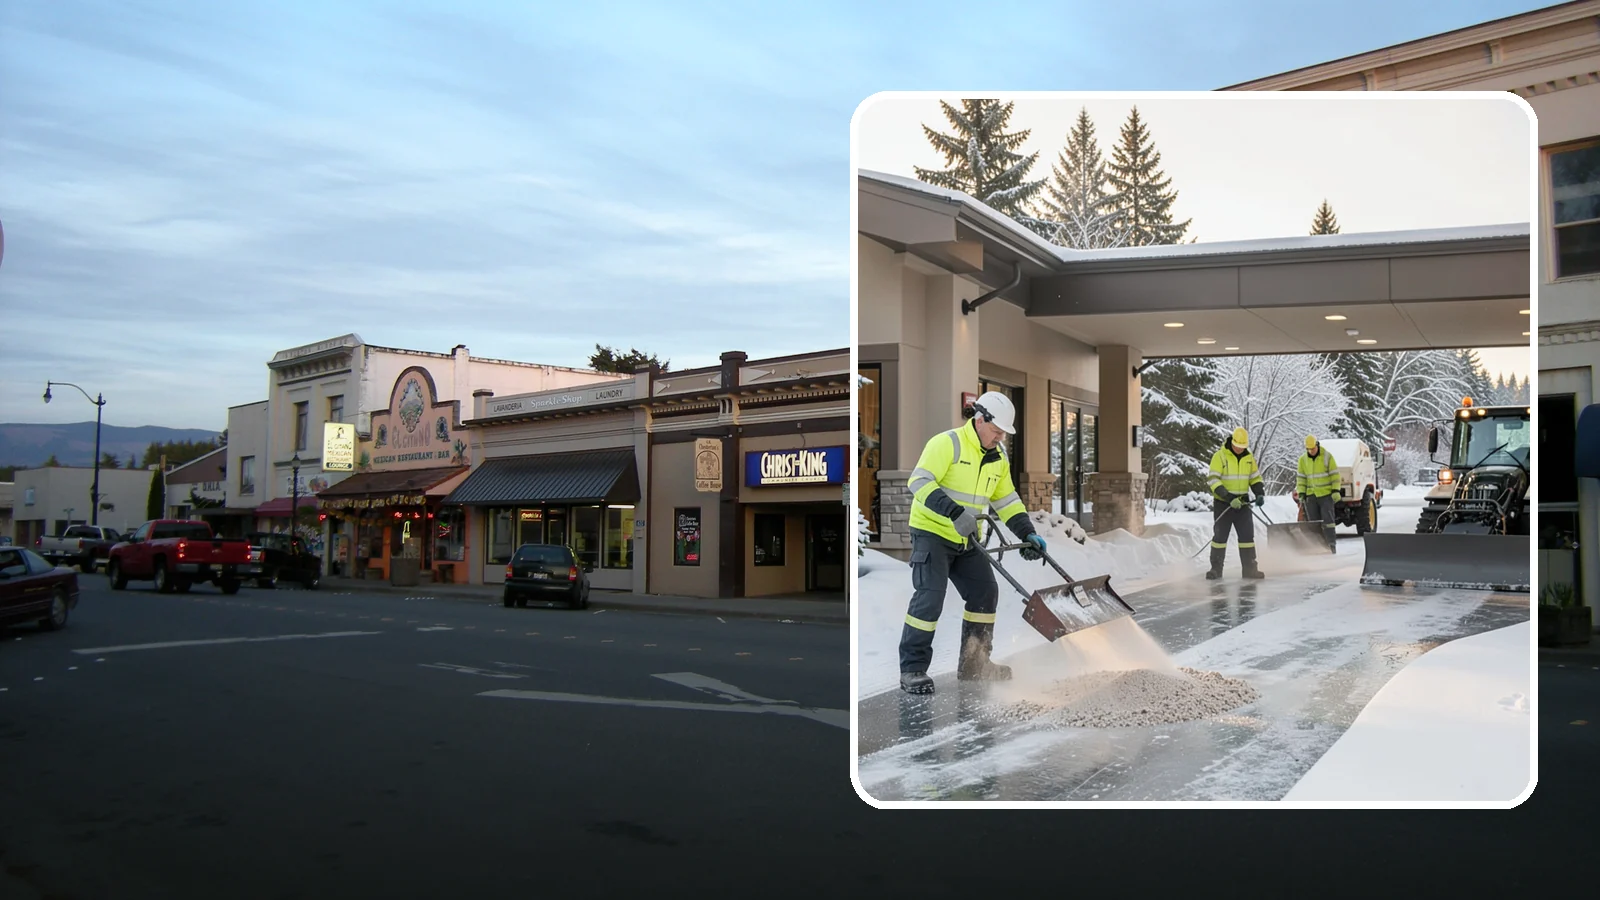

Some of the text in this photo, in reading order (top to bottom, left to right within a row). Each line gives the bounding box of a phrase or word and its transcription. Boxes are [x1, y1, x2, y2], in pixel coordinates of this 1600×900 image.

[562, 394, 583, 405] Shop
[596, 389, 623, 400] LAUNDRY
[493, 402, 522, 412] LAVANDERIA
[374, 450, 450, 464] MEXICAN RESTAURANT BAR
[760, 450, 828, 478] CHRIST KING
[697, 480, 709, 489] Coffee
